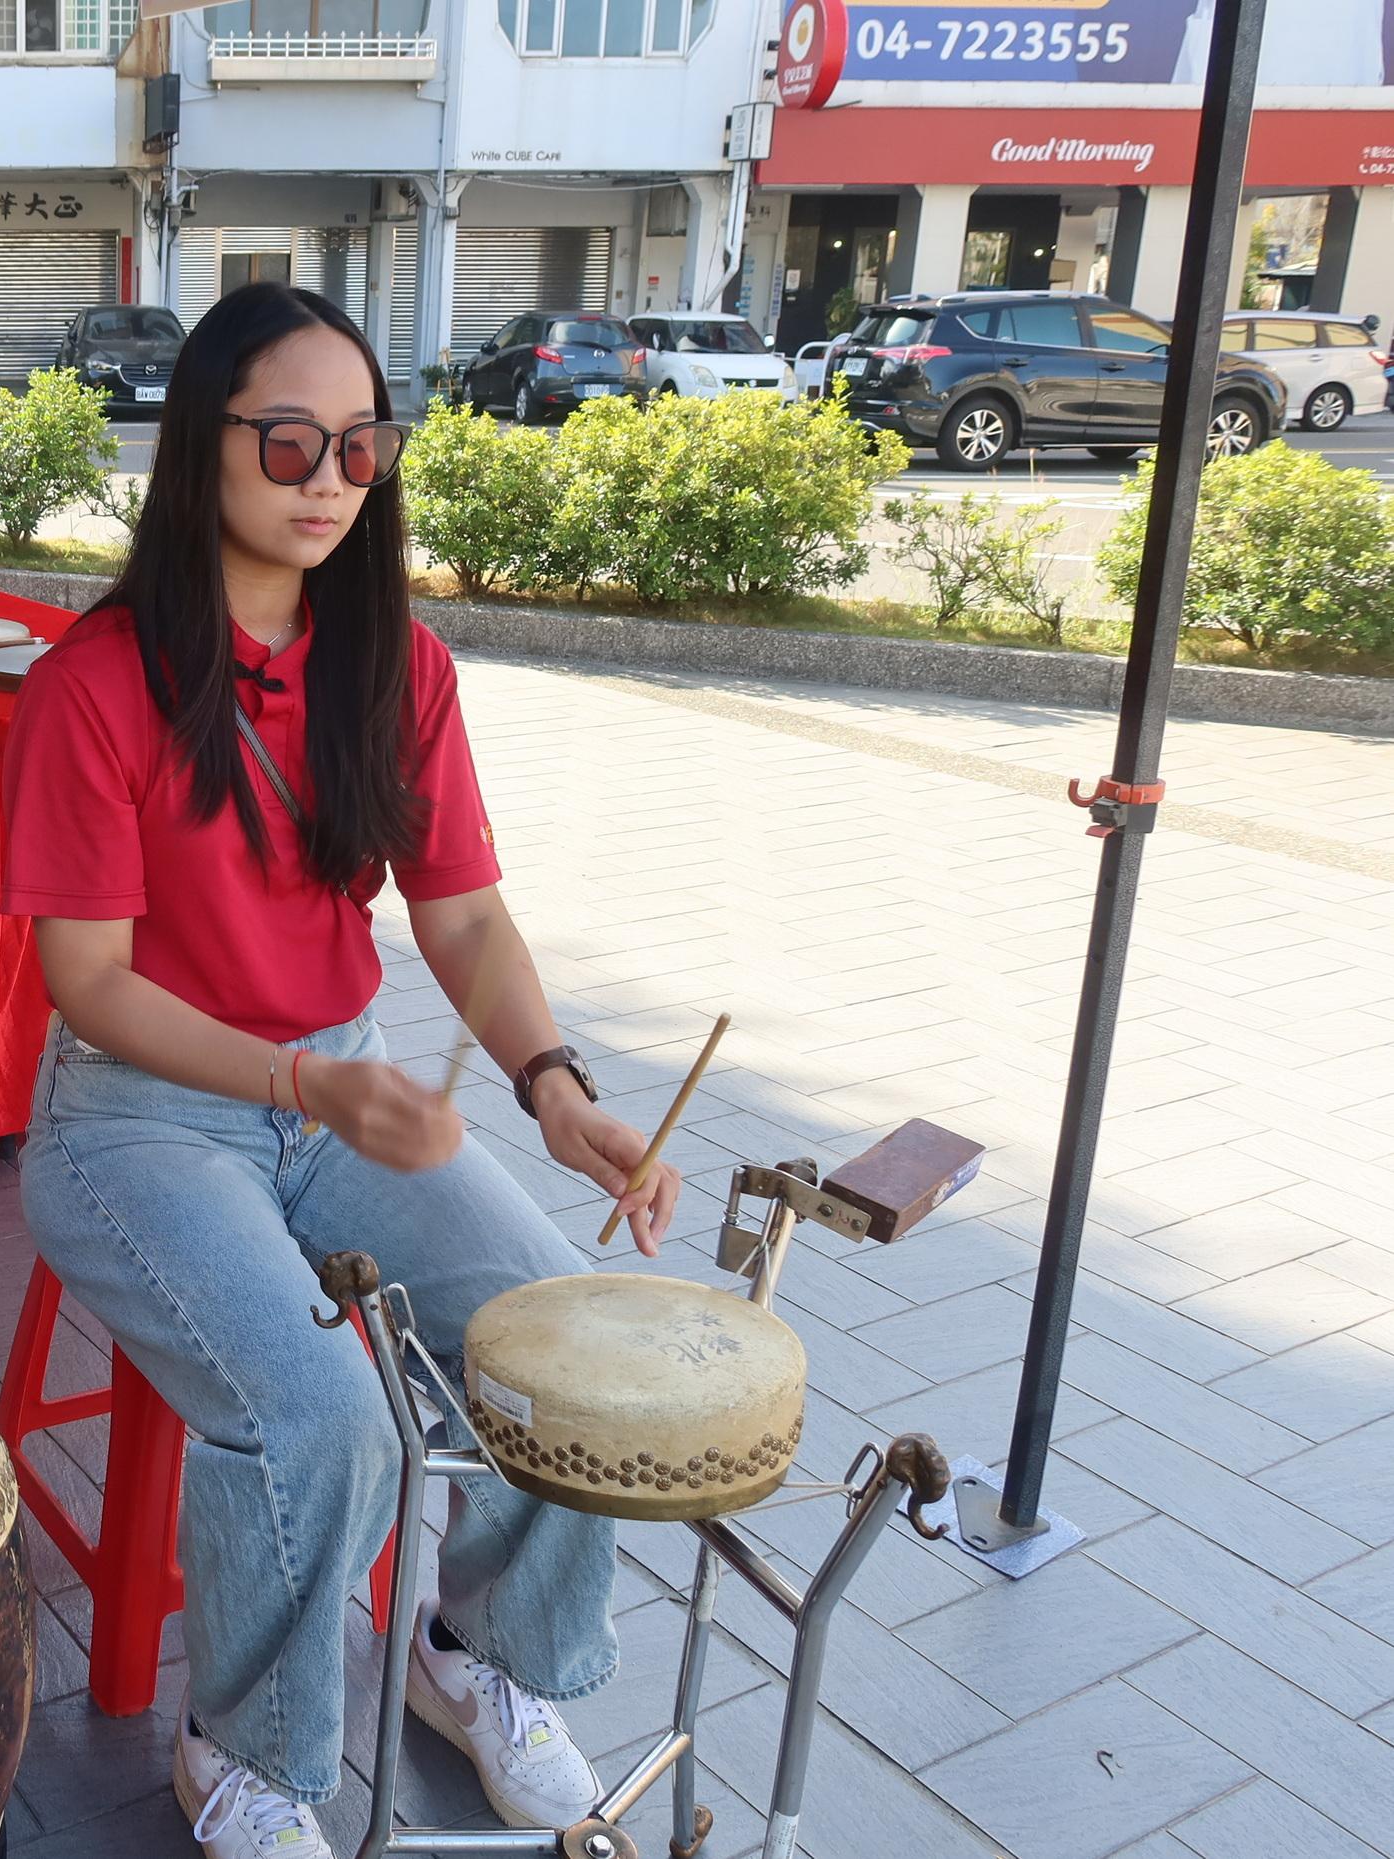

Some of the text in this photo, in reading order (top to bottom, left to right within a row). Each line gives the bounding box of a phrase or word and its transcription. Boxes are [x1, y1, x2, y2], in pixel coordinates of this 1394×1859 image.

[856, 19, 1131, 63] 04-7223555
[505, 150, 532, 161] CUBE
[991, 137, 1154, 173] Good Morning
